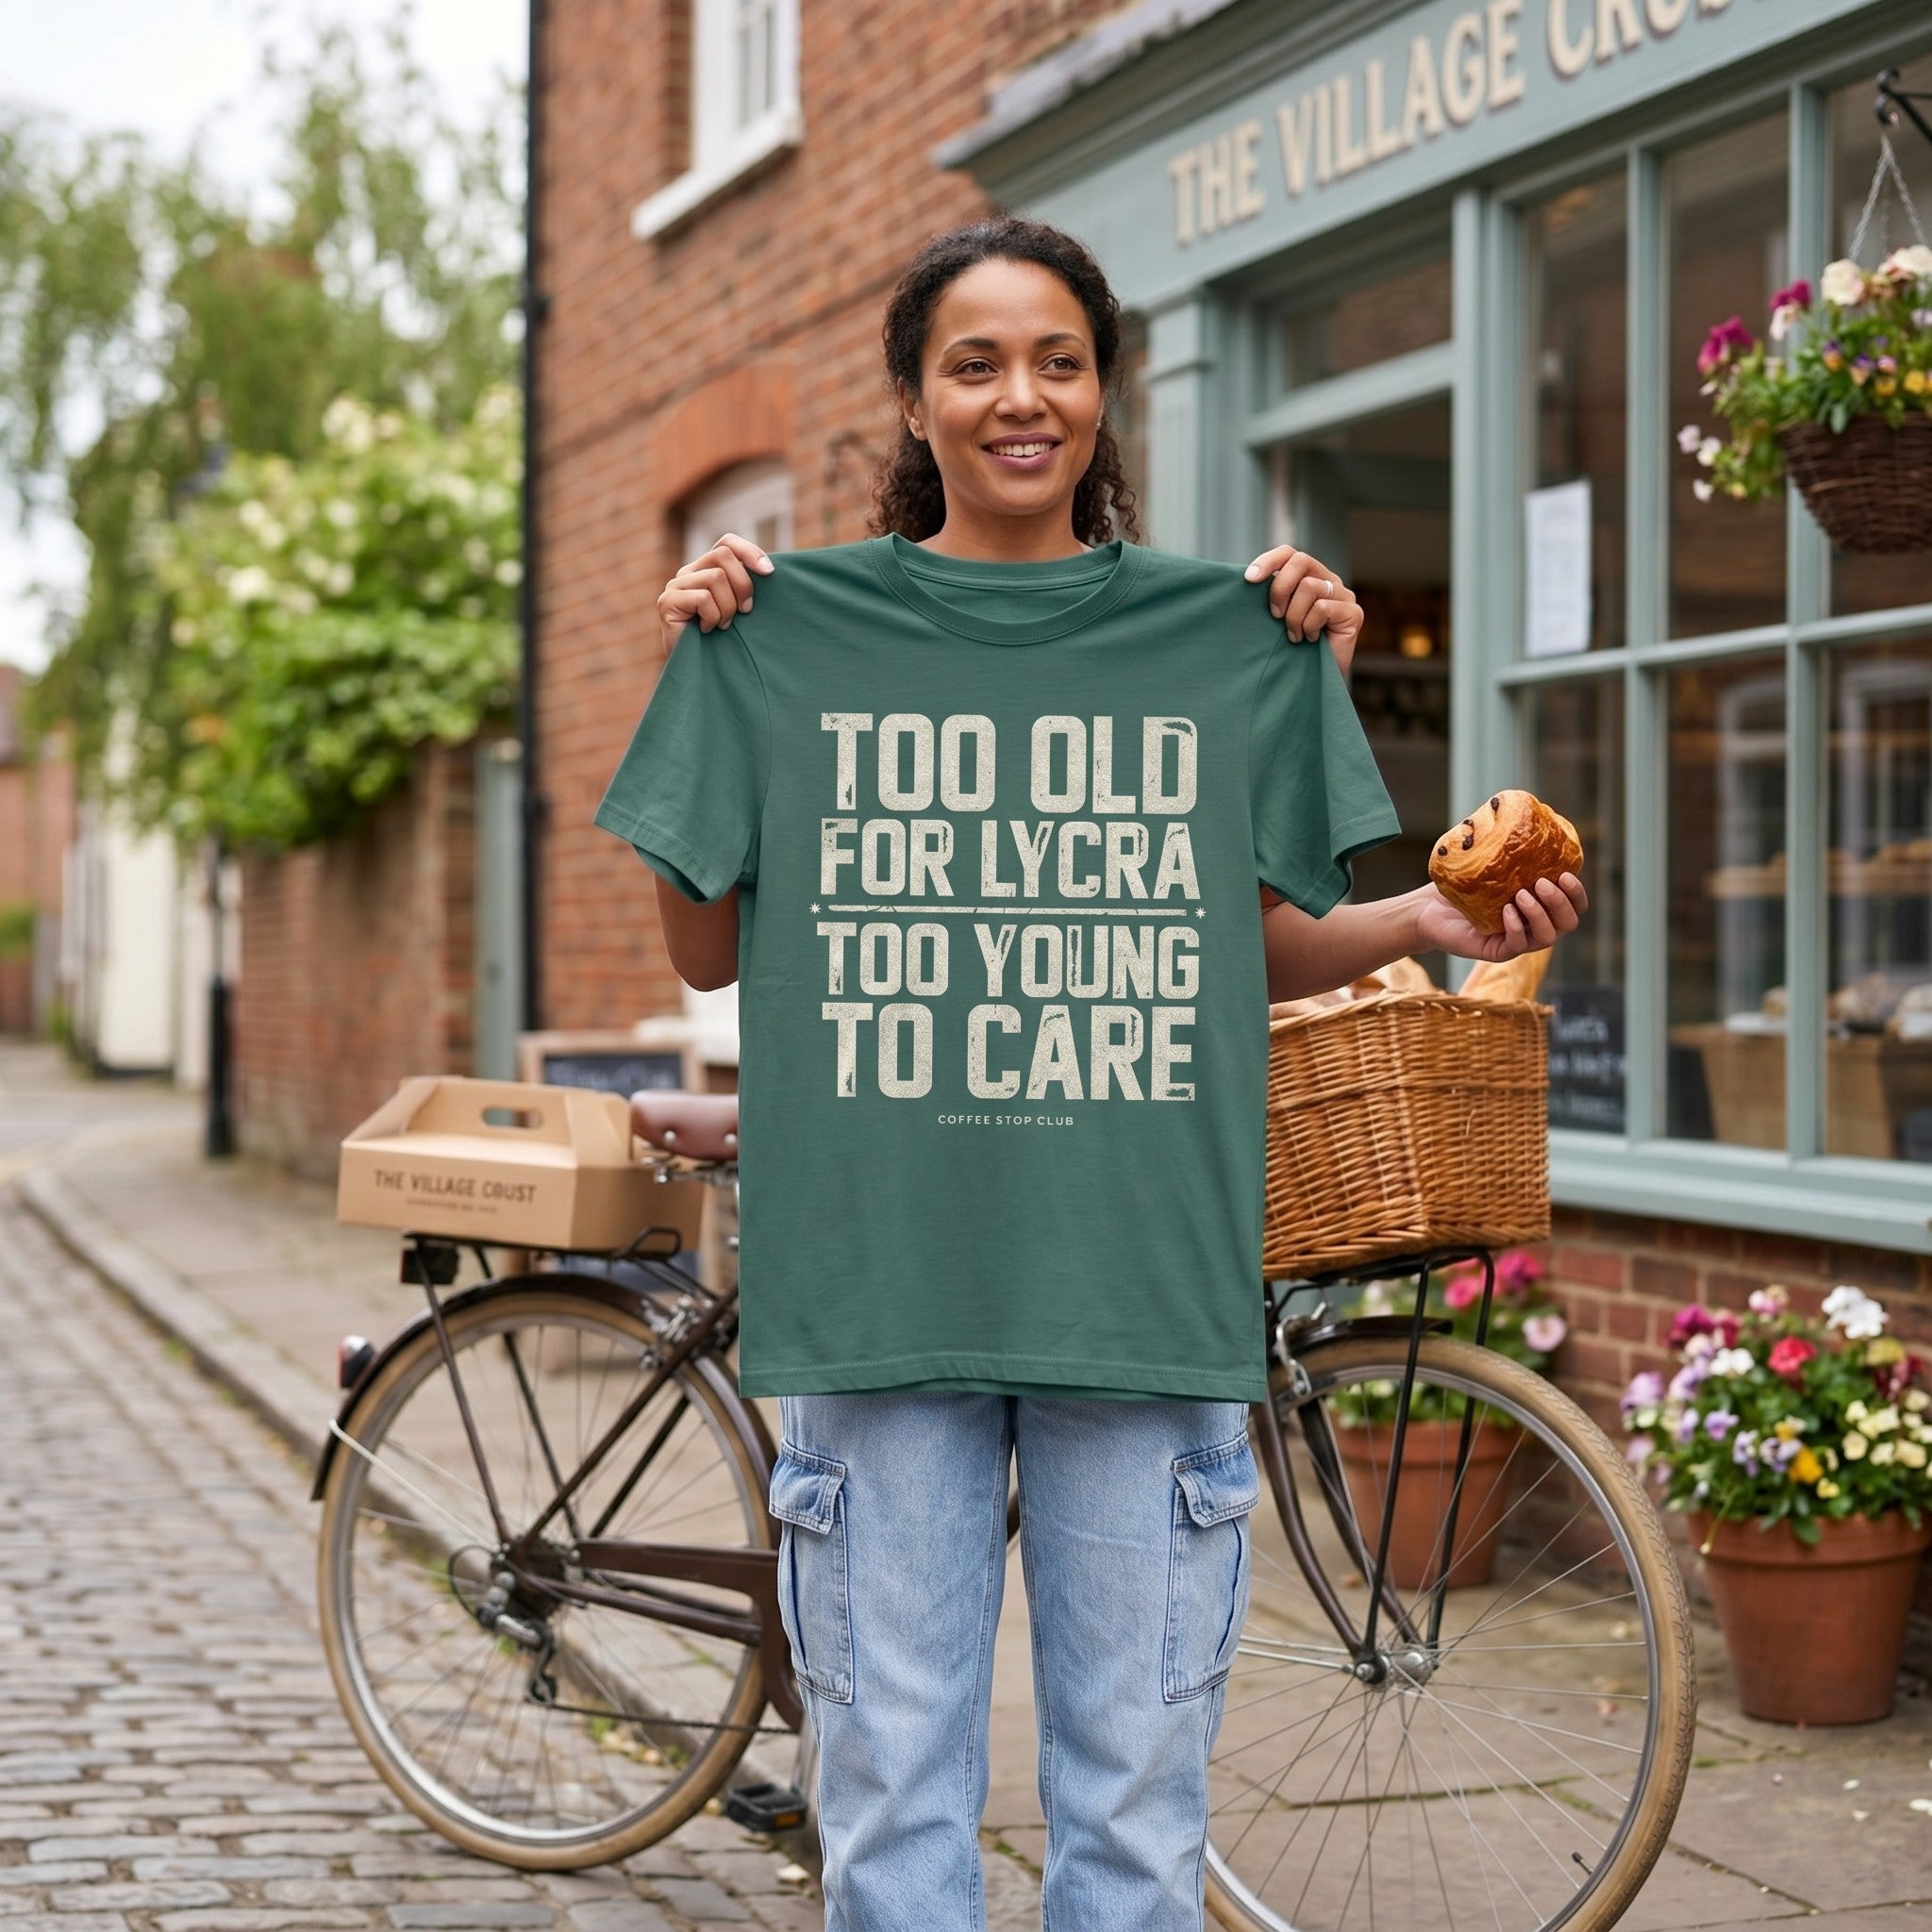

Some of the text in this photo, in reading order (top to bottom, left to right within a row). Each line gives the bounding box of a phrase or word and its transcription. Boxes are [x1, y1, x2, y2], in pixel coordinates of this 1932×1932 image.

[1168, 118, 1265, 246] THE
[1275, 8, 1526, 198] VILLAGE
[821, 712, 1198, 815] TOO OLD
[820, 817, 1201, 900] FOR LYCRA
[816, 921, 1200, 1000] TOO YOUNG
[822, 1002, 1196, 1101] TO CARE
[938, 1114, 1074, 1126] COFFEE STOP CLUB
[375, 1169, 405, 1191] THE
[410, 1173, 476, 1198] VILLAGE
